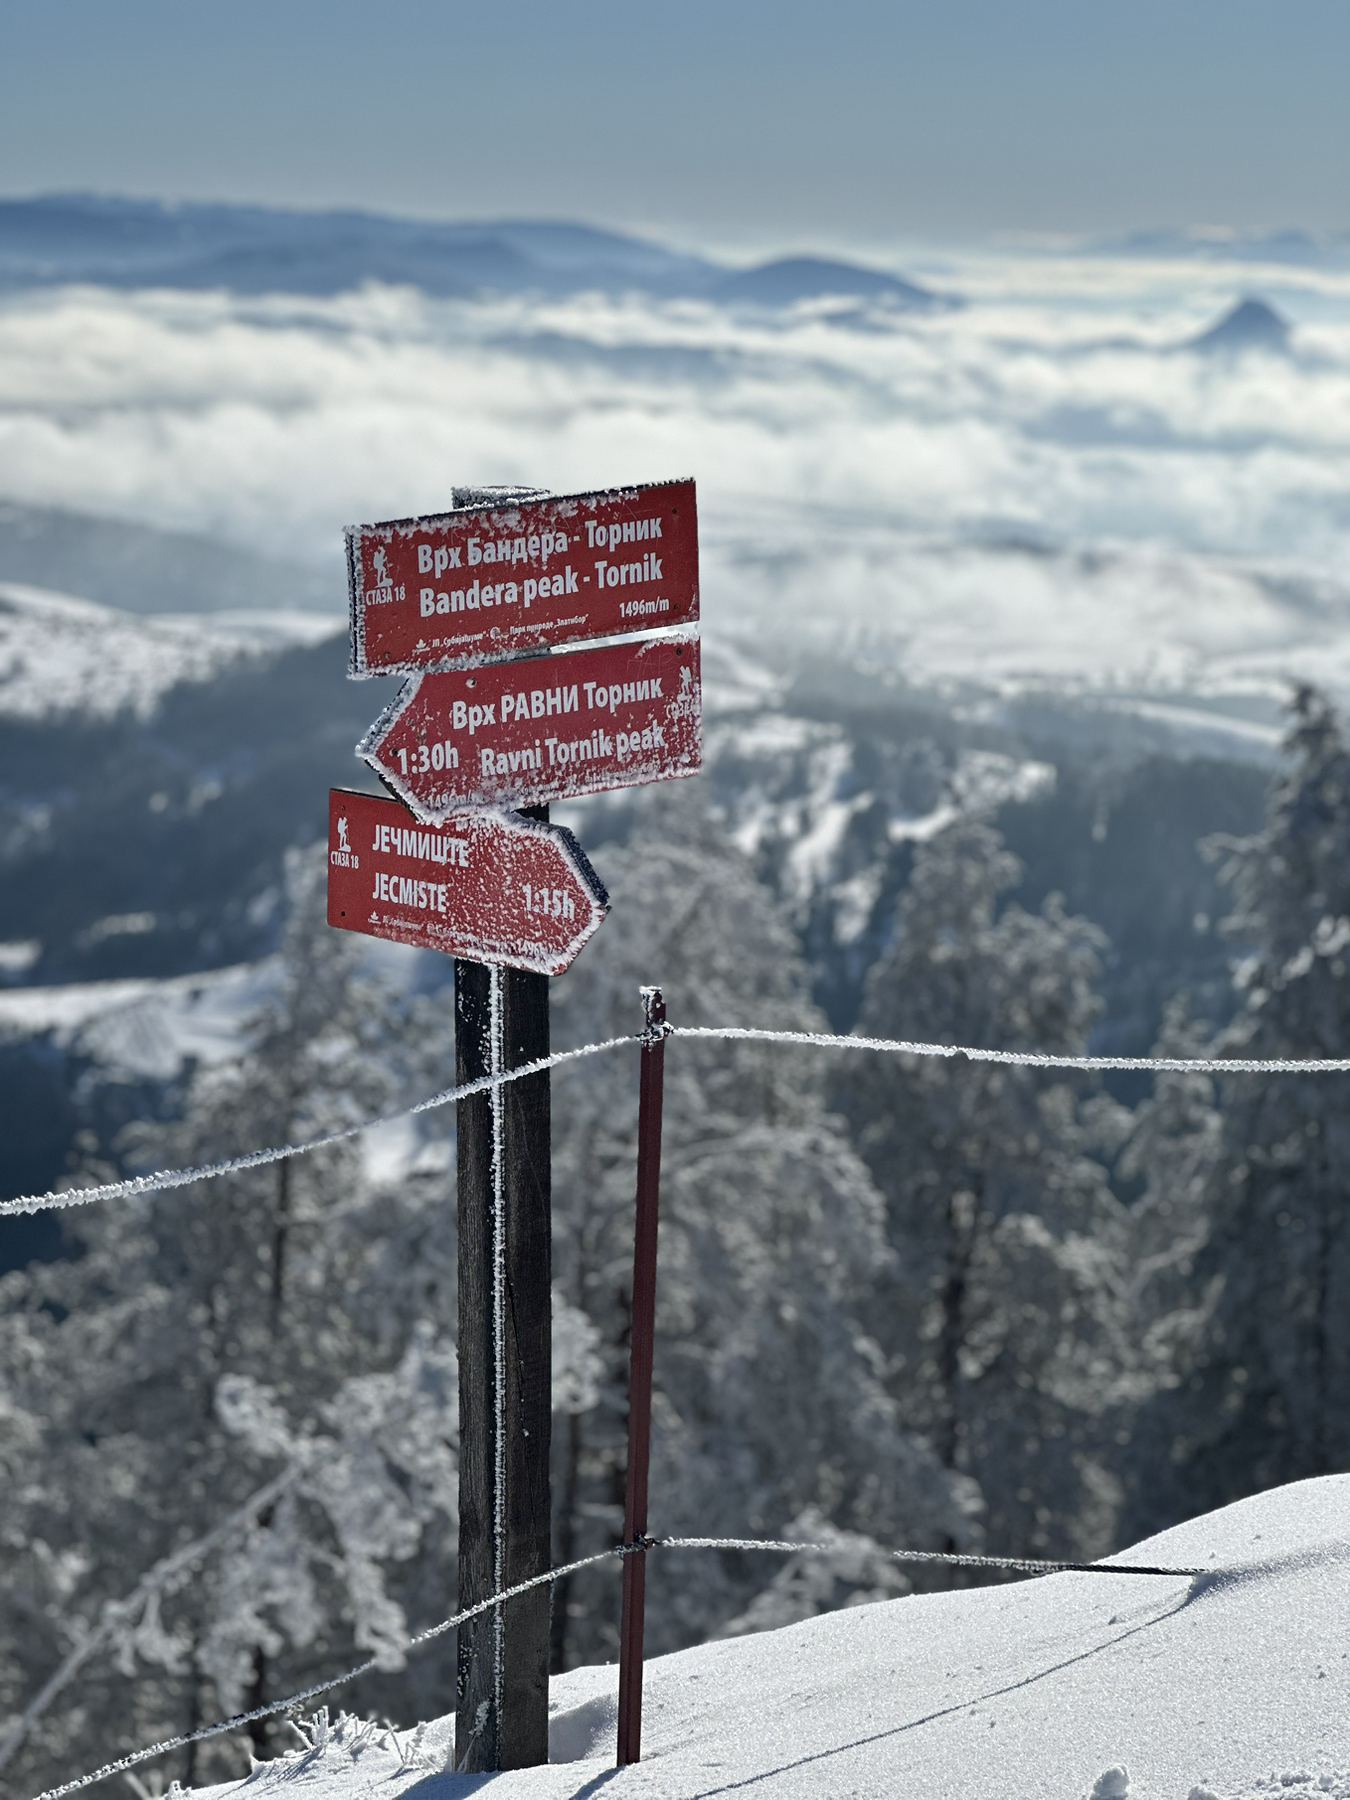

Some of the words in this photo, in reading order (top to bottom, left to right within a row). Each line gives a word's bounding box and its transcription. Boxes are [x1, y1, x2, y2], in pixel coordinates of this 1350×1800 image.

[418, 543, 461, 578] Врх
[467, 531, 568, 565] Бандера
[585, 517, 662, 551] Торник
[366, 587, 393, 605] СТАЗА
[394, 585, 406, 601] 18
[420, 579, 518, 618] Bandera
[524, 566, 578, 608] peak
[594, 552, 663, 590] Tornik
[619, 597, 670, 618] 1496m/m
[452, 701, 496, 735] Врх
[501, 684, 579, 722] РАВНИ
[583, 677, 664, 713] Торник
[398, 741, 459, 775] 1:30h
[481, 742, 541, 777] Ravni
[545, 730, 613, 766] Tornik
[616, 719, 667, 762] peak
[330, 850, 350, 868] СТАЗА
[351, 854, 360, 869] 18
[372, 824, 469, 867] ЈЕЧМИШТЕ
[372, 872, 448, 913] JECMISTE
[522, 884, 575, 921] 1:15h
